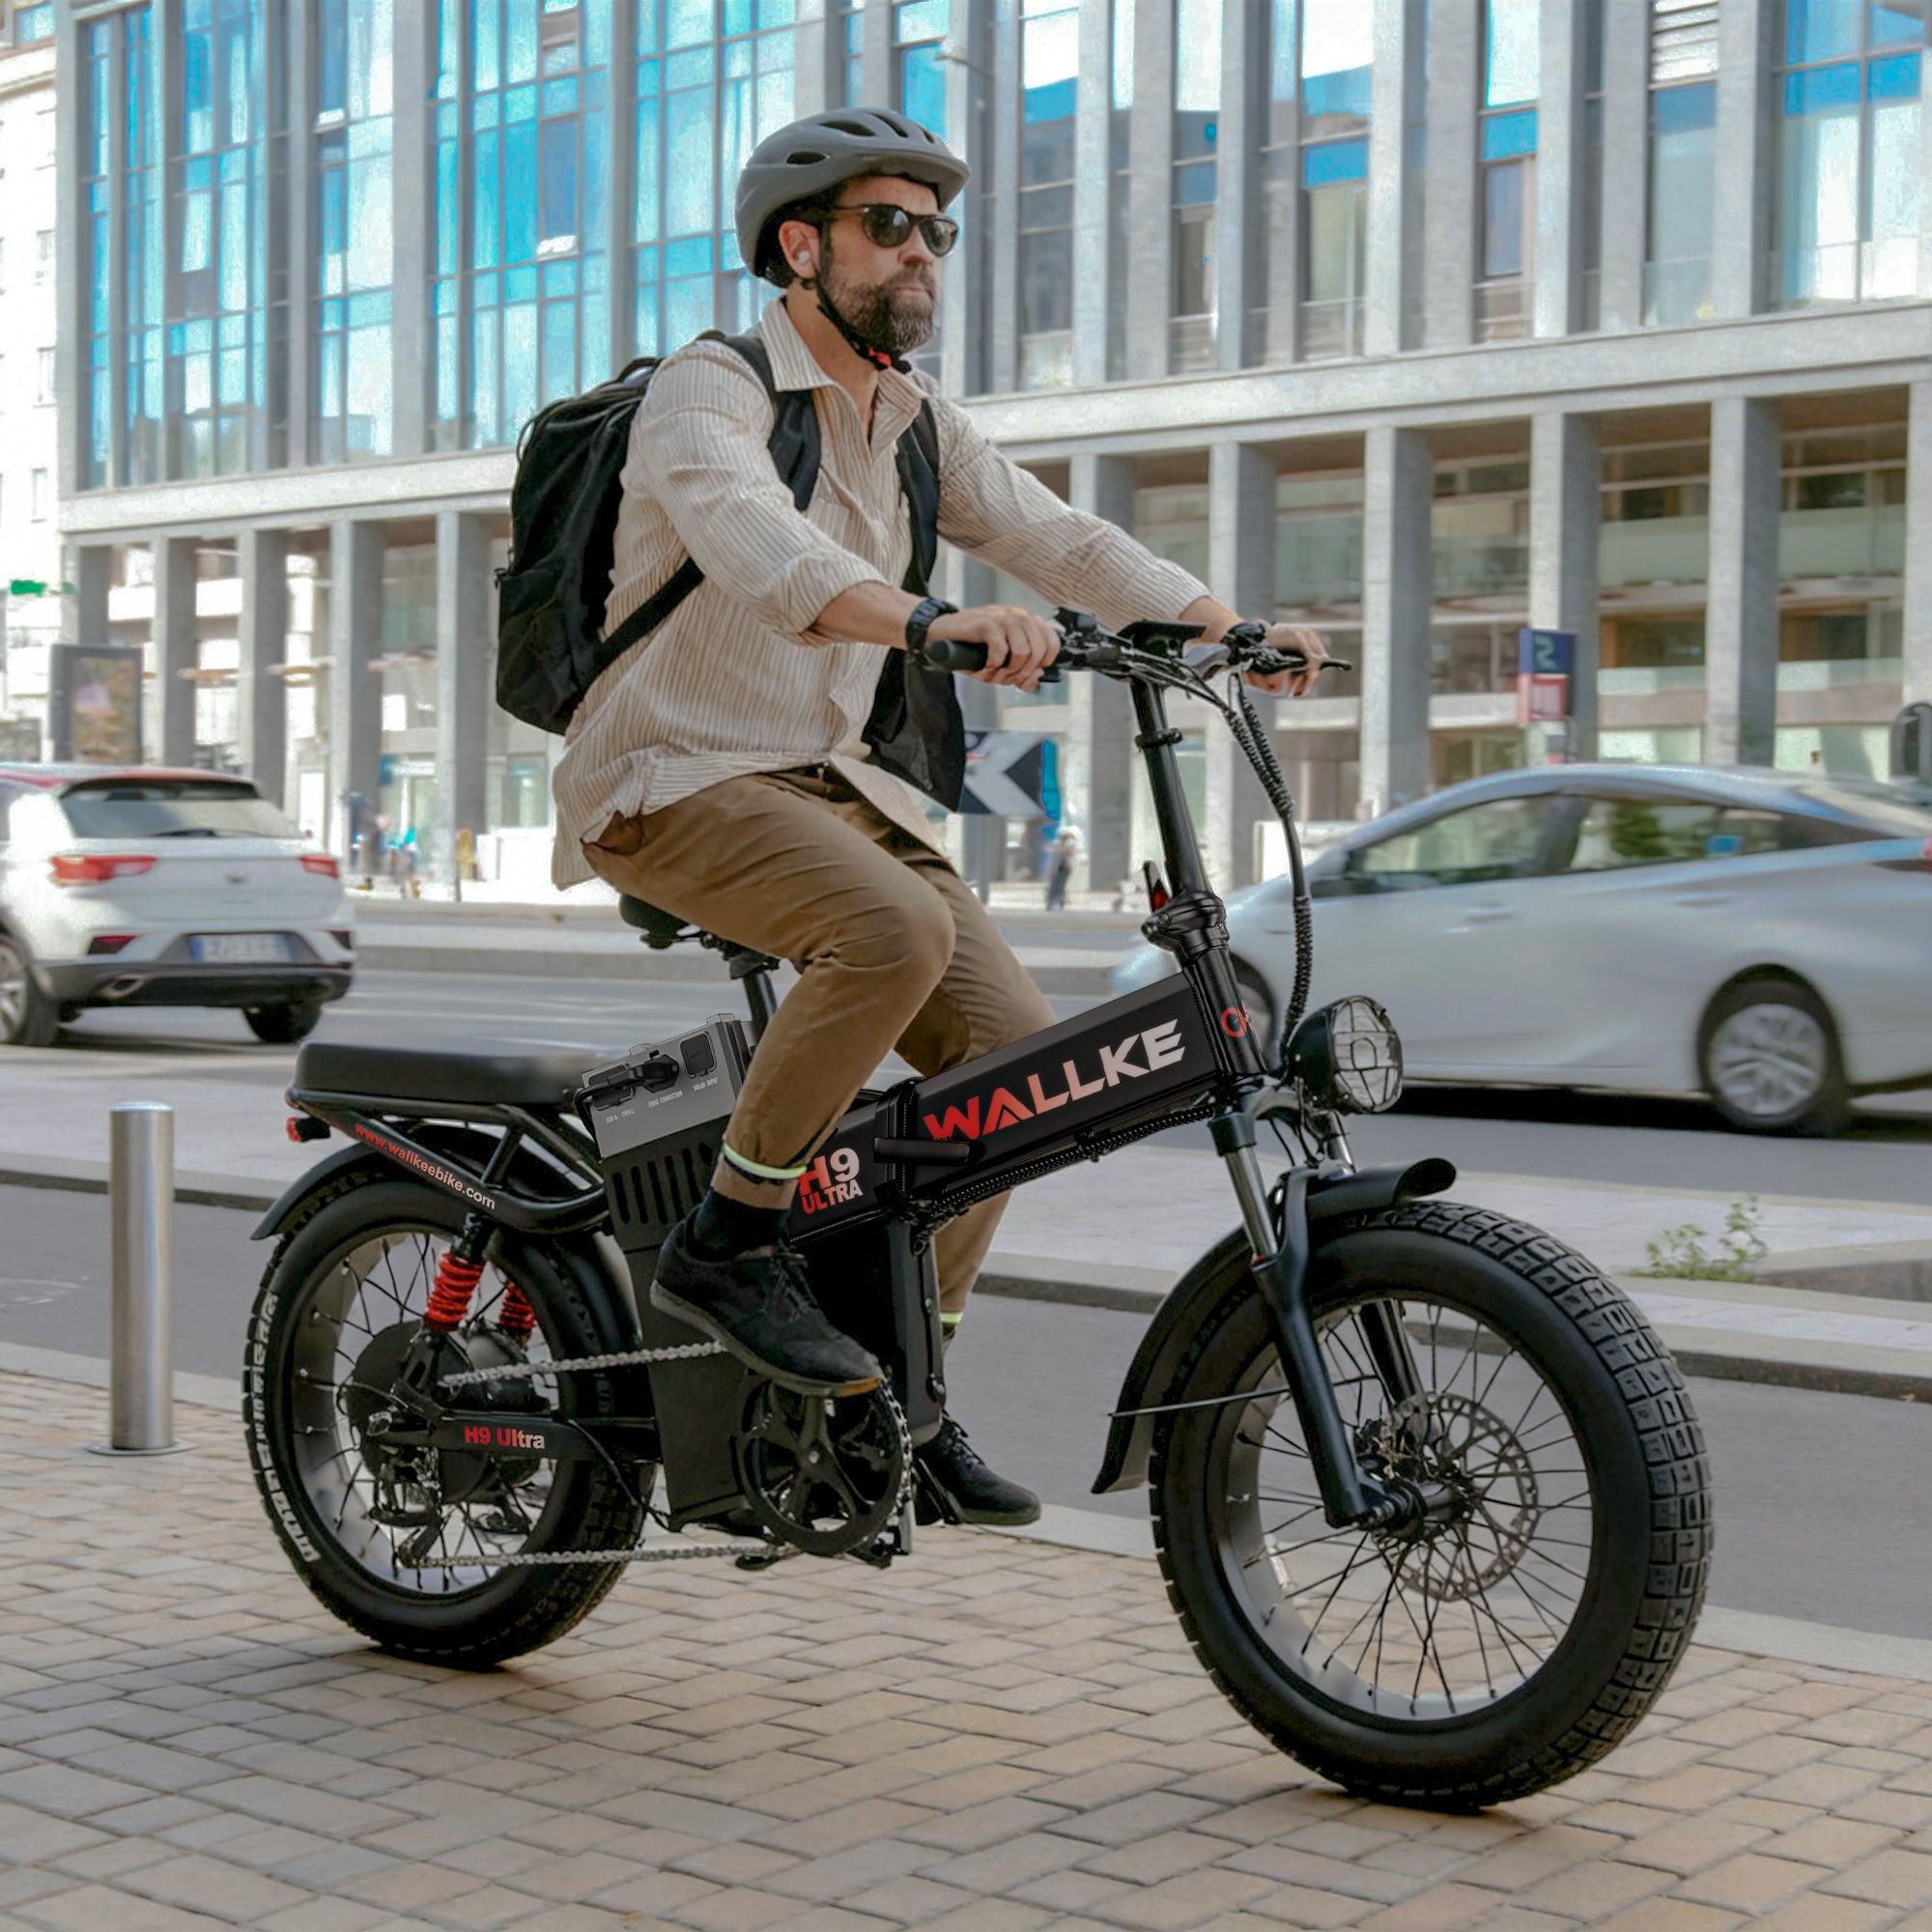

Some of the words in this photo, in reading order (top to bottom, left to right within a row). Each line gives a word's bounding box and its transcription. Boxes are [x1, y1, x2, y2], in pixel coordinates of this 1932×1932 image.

[923, 1018, 1186, 1141] WALLKE
[355, 1123, 496, 1209] www.wallkeebike.com
[798, 1147, 860, 1197] H9
[801, 1179, 864, 1214] ULTRA
[464, 1425, 492, 1446] H9
[496, 1427, 546, 1450] Ultra
